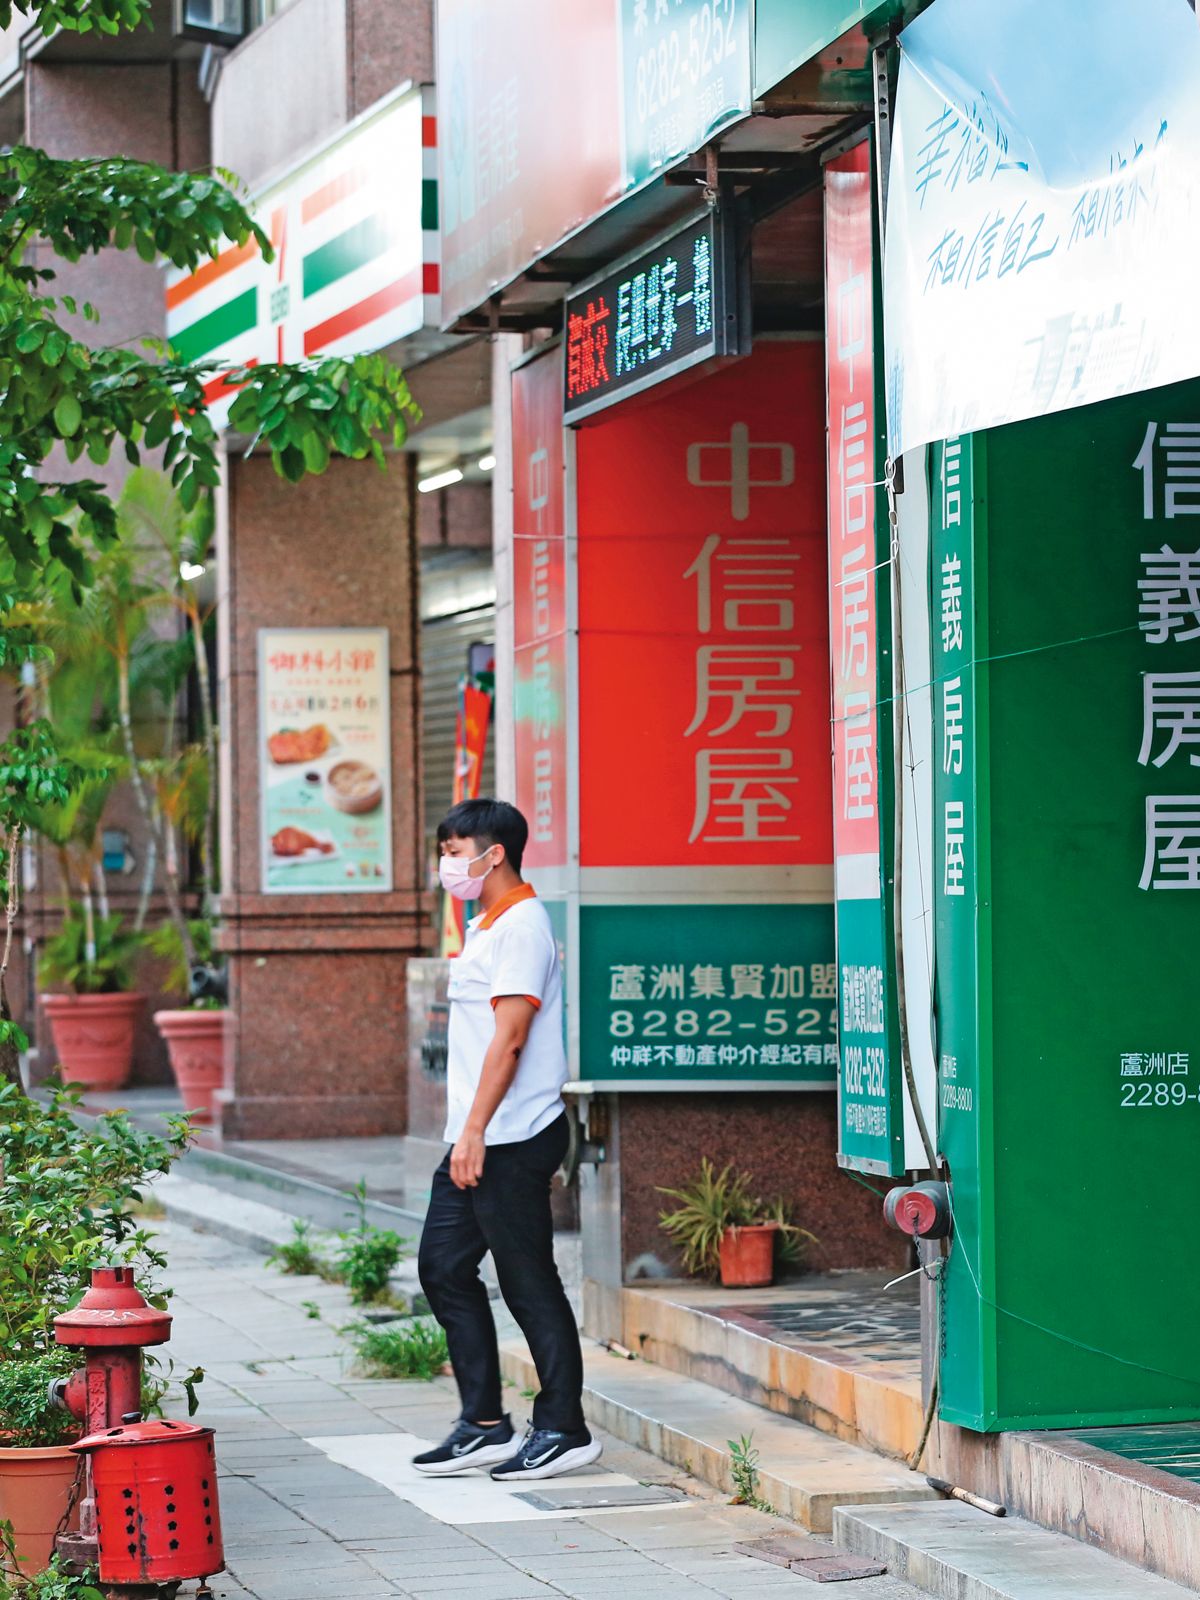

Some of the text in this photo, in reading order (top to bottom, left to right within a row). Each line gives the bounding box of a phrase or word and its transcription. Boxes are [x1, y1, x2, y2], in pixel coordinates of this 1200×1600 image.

[923, 200, 1060, 295] 相信自己
[837, 256, 874, 821] 中信房屋
[528, 438, 553, 843] 中信房屋
[683, 421, 802, 845] 中信房屋
[941, 432, 965, 897] 信義房屋
[609, 963, 837, 1000] 蘆洲集賢加盟
[845, 1045, 886, 1098] 8282-5252
[943, 1083, 973, 1111] 2289-8800
[1119, 1052, 1189, 1077] 蘆洲店
